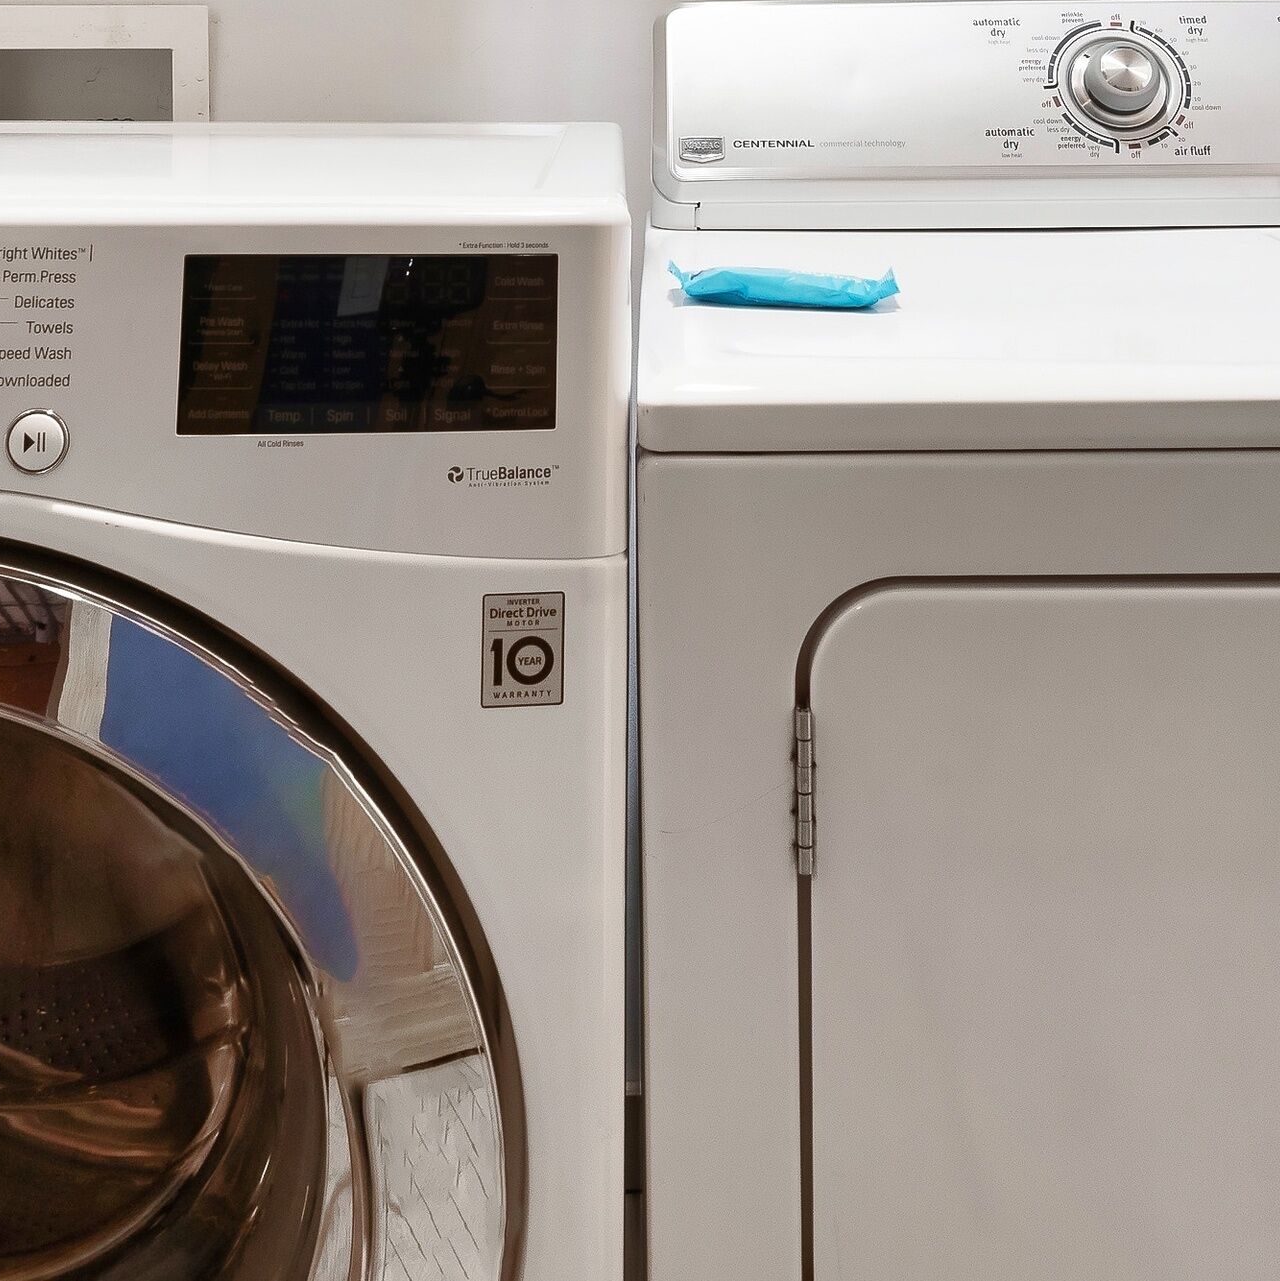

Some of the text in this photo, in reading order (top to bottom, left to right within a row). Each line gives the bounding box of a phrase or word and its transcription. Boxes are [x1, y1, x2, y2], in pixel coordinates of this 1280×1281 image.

[972, 17, 1021, 26] automatic
[1110, 13, 1121, 21] off
[1179, 15, 1207, 24] timed
[990, 27, 1006, 38] dry
[1187, 26, 1203, 36] dry
[1041, 100, 1052, 109] off
[1183, 121, 1194, 129] off
[985, 127, 1035, 136] automatic
[733, 140, 815, 148] CENTENNIAL
[819, 139, 907, 149] commercial technology
[1003, 139, 1019, 150] dry
[1057, 142, 1086, 150] preferred
[1130, 150, 1141, 159] off
[1174, 145, 1211, 156] air fluff
[517, 276, 544, 286] Wash
[14, 295, 75, 309] Delicates
[26, 320, 74, 334] Towels
[34, 346, 72, 360] Wash
[327, 409, 354, 424] Spin
[386, 408, 407, 421] Soil
[434, 408, 471, 424] Signal
[257, 440, 304, 448] All Cold Rinses
[468, 480, 522, 488] Anti-Vibration
[506, 598, 540, 606] INVERTER
[489, 606, 558, 619] Direct Drive
[506, 619, 540, 627] MOTOR
[490, 635, 555, 686] 10
[518, 656, 543, 666] YEAR
[492, 689, 552, 700] WARRANTY
